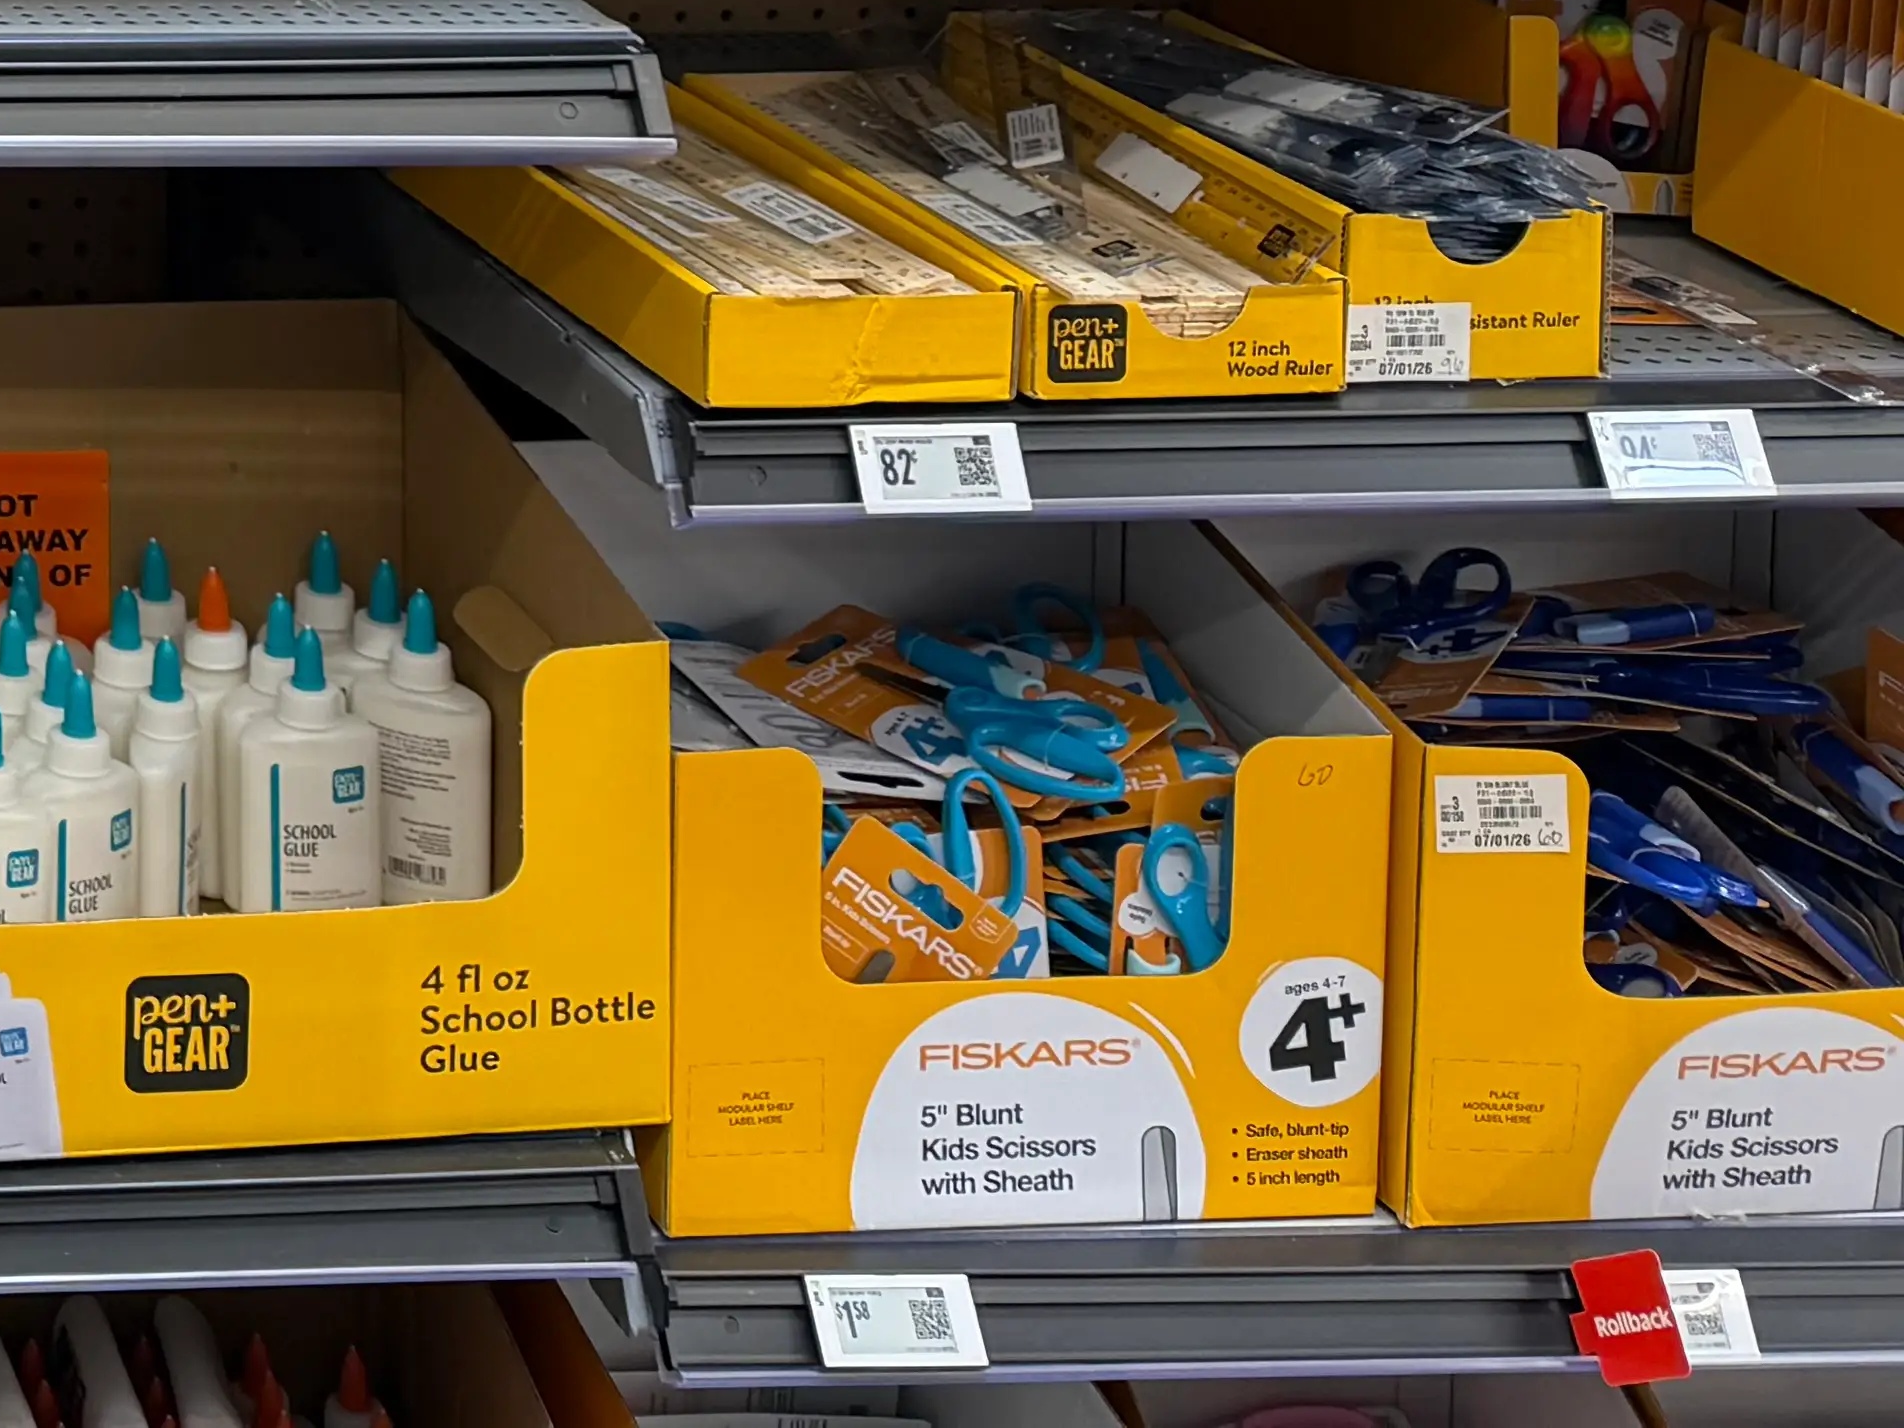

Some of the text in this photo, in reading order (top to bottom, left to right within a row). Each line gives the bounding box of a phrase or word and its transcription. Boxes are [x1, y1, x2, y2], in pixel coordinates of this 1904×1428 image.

[1532, 311, 1580, 329] Ruler
[1059, 340, 1116, 371] GEAR
[1228, 358, 1332, 378] Wood Ruler
[1379, 361, 1433, 378] 07/01/26
[785, 622, 897, 701] FISKARS
[283, 823, 337, 845] SCHOOL
[1473, 832, 1532, 848] 07/01/26
[283, 841, 320, 859] GLUE
[418, 990, 656, 1036] School Bottle
[142, 1026, 231, 1075] GEAR
[919, 1039, 1131, 1072] FISKARS
[1244, 1120, 1349, 1141] Safe, blunt-tip
[921, 1132, 1097, 1162] Kids Scissors
[1662, 1164, 1811, 1190] with Sheath
[1594, 1305, 1673, 1338] Rollback
